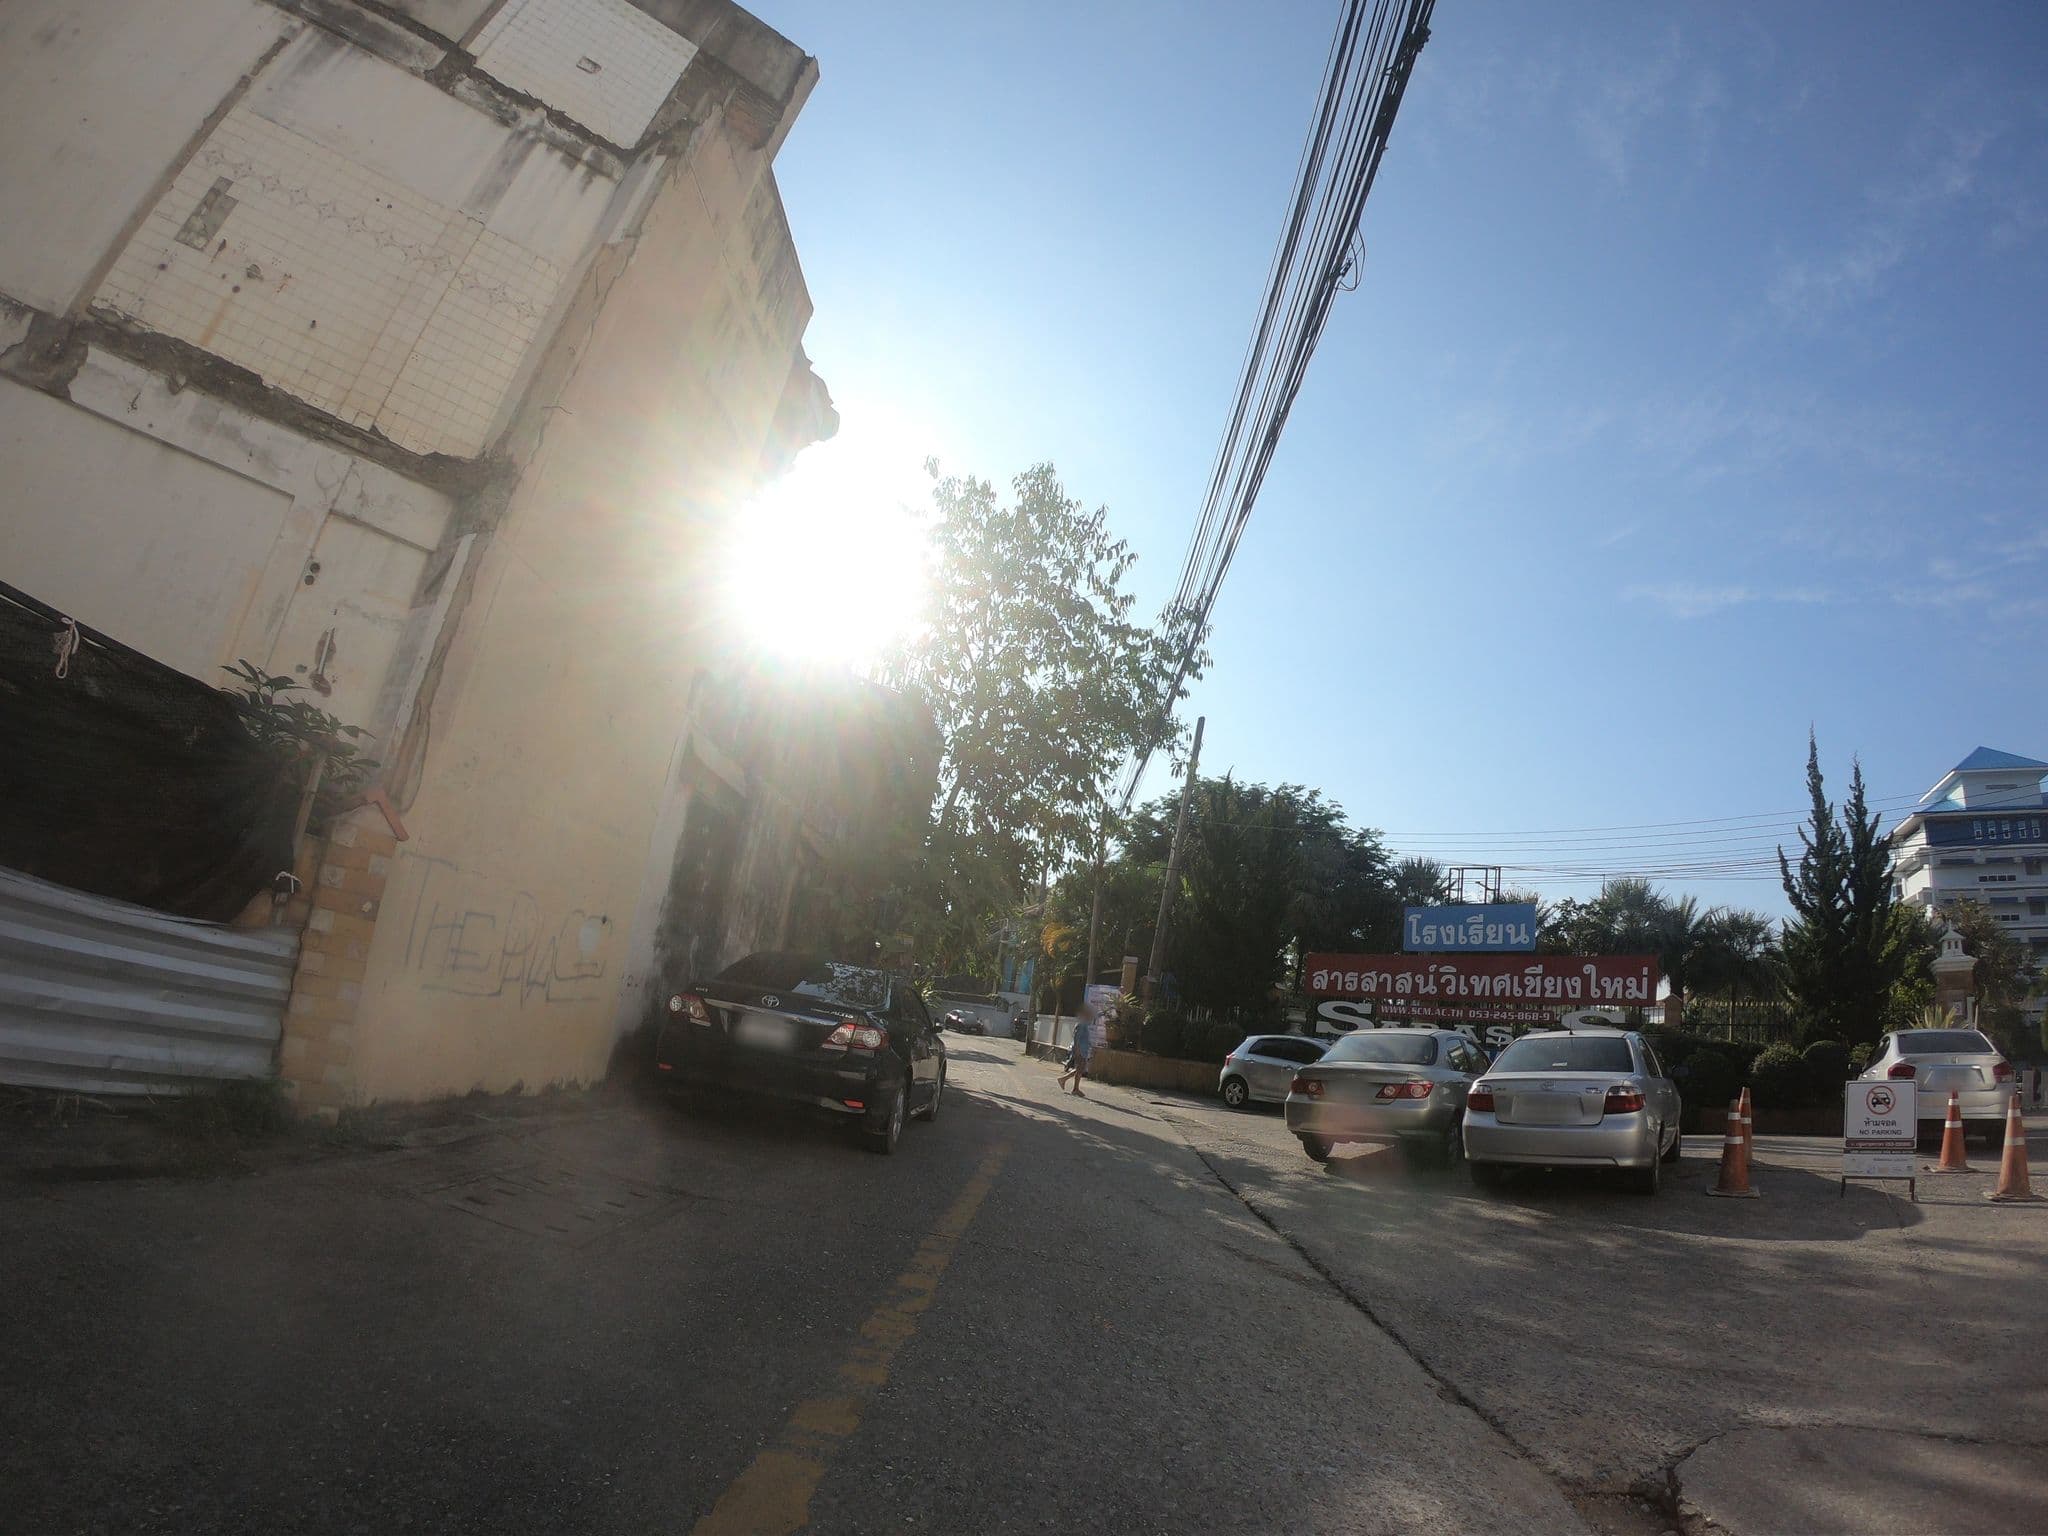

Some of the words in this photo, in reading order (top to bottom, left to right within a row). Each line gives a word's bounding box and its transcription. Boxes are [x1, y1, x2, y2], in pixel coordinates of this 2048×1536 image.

[1408, 913, 1530, 946] โรงเรียน
[1311, 963, 1649, 1001] สารสาสน์วิเทศเชียงใหม่
[1380, 1005, 1464, 1018] WWW.SCM.AC.TH
[1863, 1117, 1897, 1127] ห้ามจอด
